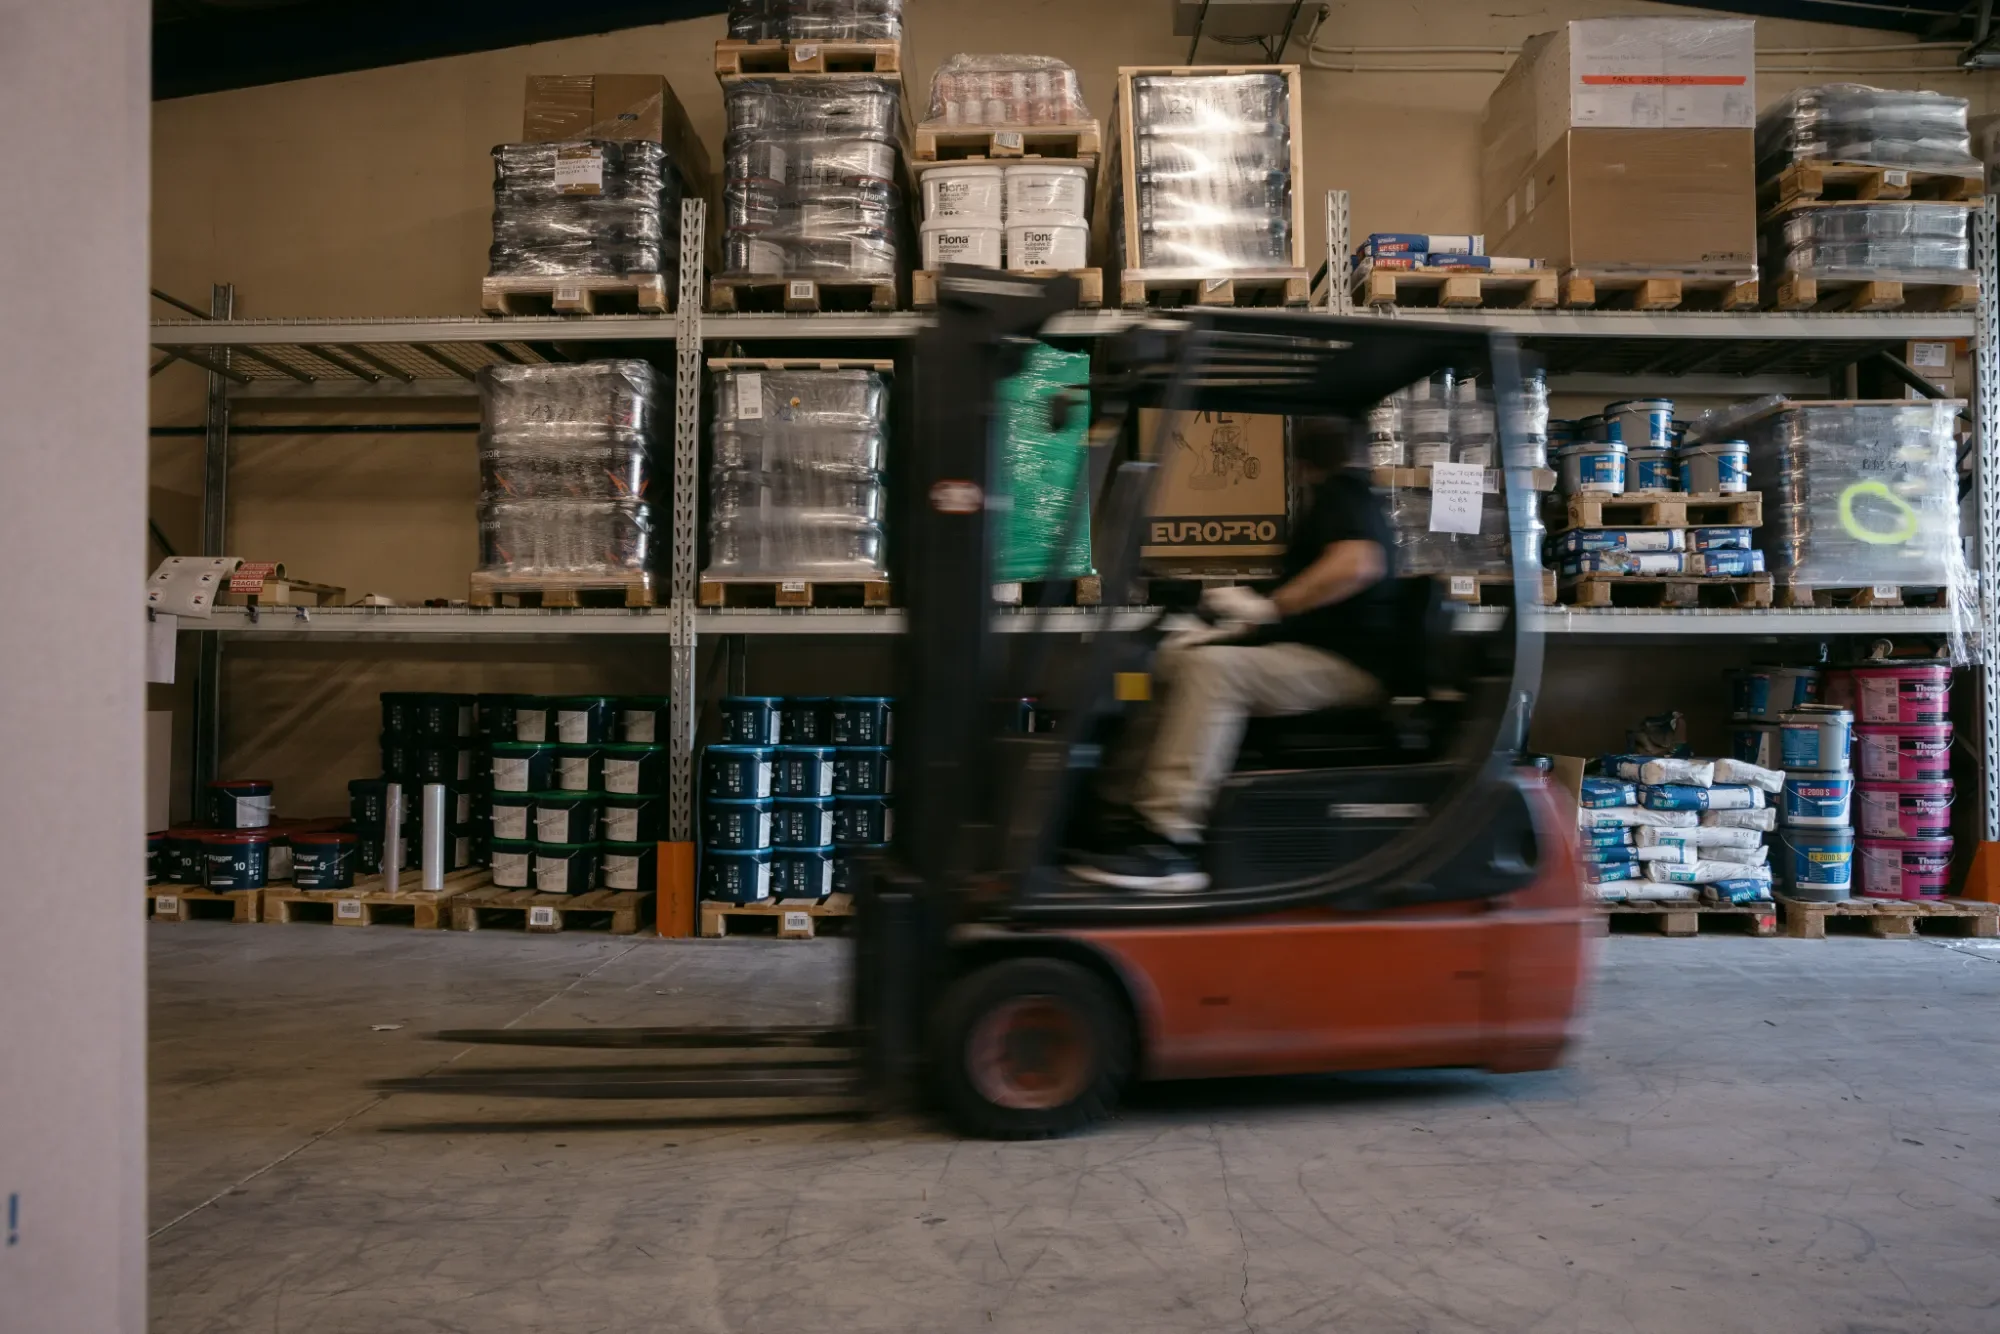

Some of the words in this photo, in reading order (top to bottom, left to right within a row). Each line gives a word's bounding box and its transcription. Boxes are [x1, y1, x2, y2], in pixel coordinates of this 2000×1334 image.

[938, 234, 968, 244] Fiona
[1151, 521, 1277, 543] EUROPRO
[1808, 788, 1824, 796] 2000
[181, 857, 192, 867] 10
[234, 862, 245, 871] 10
[320, 862, 326, 870] 5
